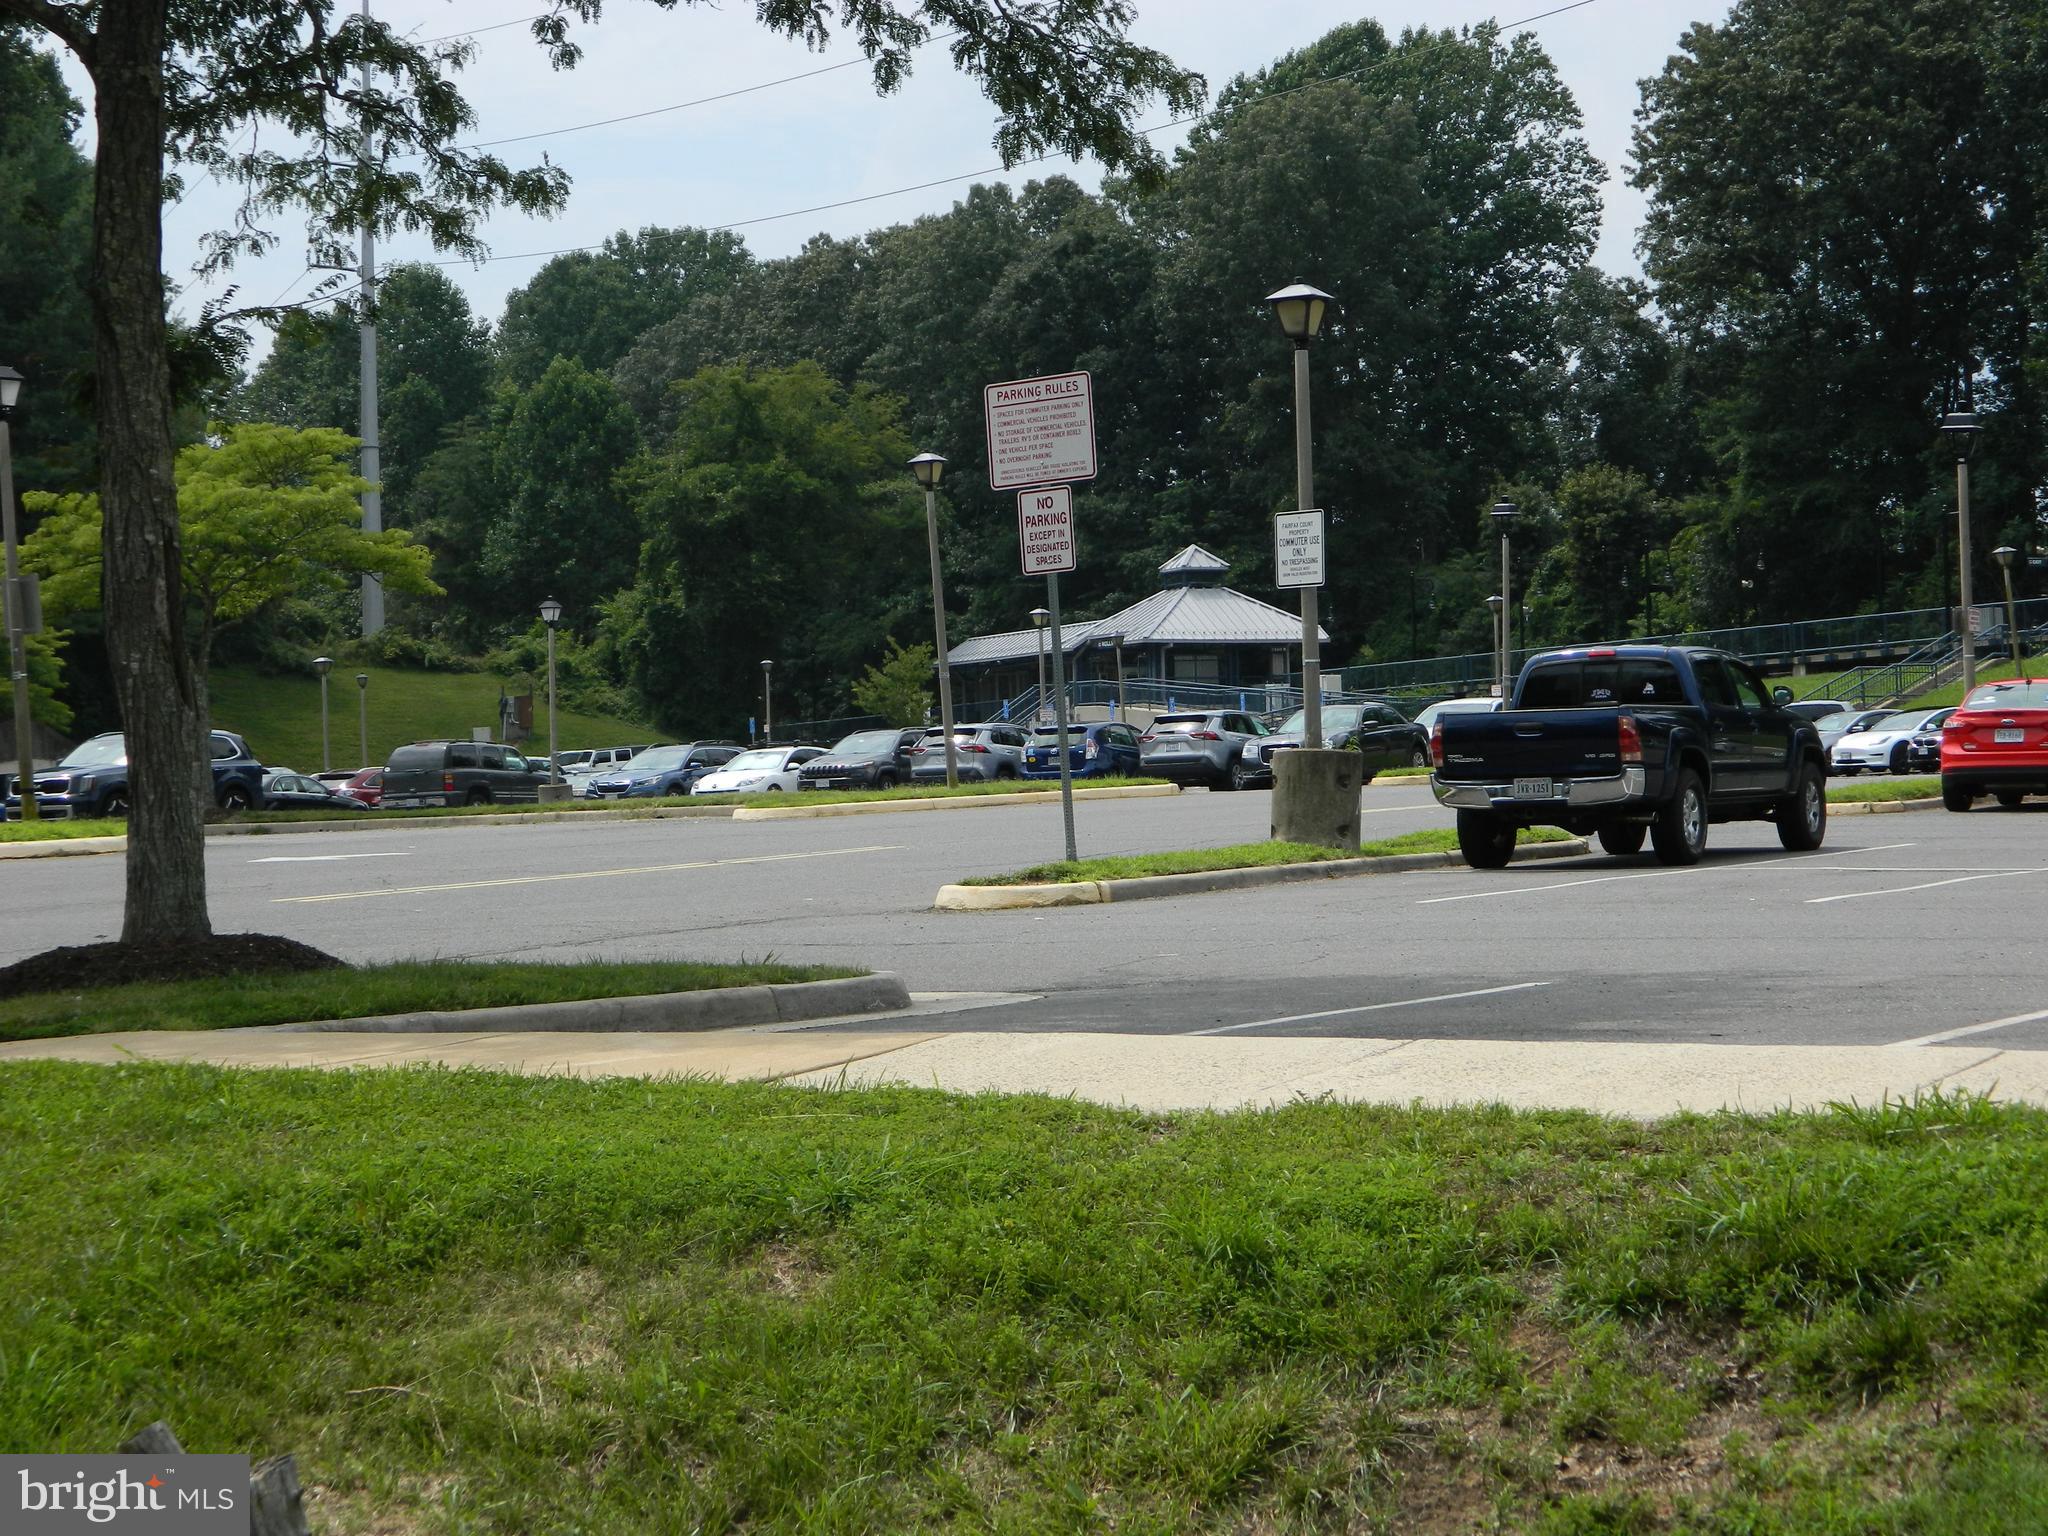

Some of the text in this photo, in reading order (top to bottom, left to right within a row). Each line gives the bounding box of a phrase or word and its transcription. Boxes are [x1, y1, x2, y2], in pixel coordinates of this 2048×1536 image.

[997, 381, 1079, 402] PARKING RULES
[1025, 406, 1049, 415] COMMUTER
[1051, 403, 1070, 411] PARKING
[1037, 496, 1054, 509] NO
[1025, 512, 1067, 528] PARKING
[1030, 529, 1065, 541] EXCEPT IN
[1027, 541, 1069, 554] DESIGNATED
[1279, 536, 1320, 547] COMMUTER USE
[1292, 548, 1306, 557] ONLY
[1036, 555, 1062, 565] SPACES
[1289, 557, 1318, 565] TRESPASSING
